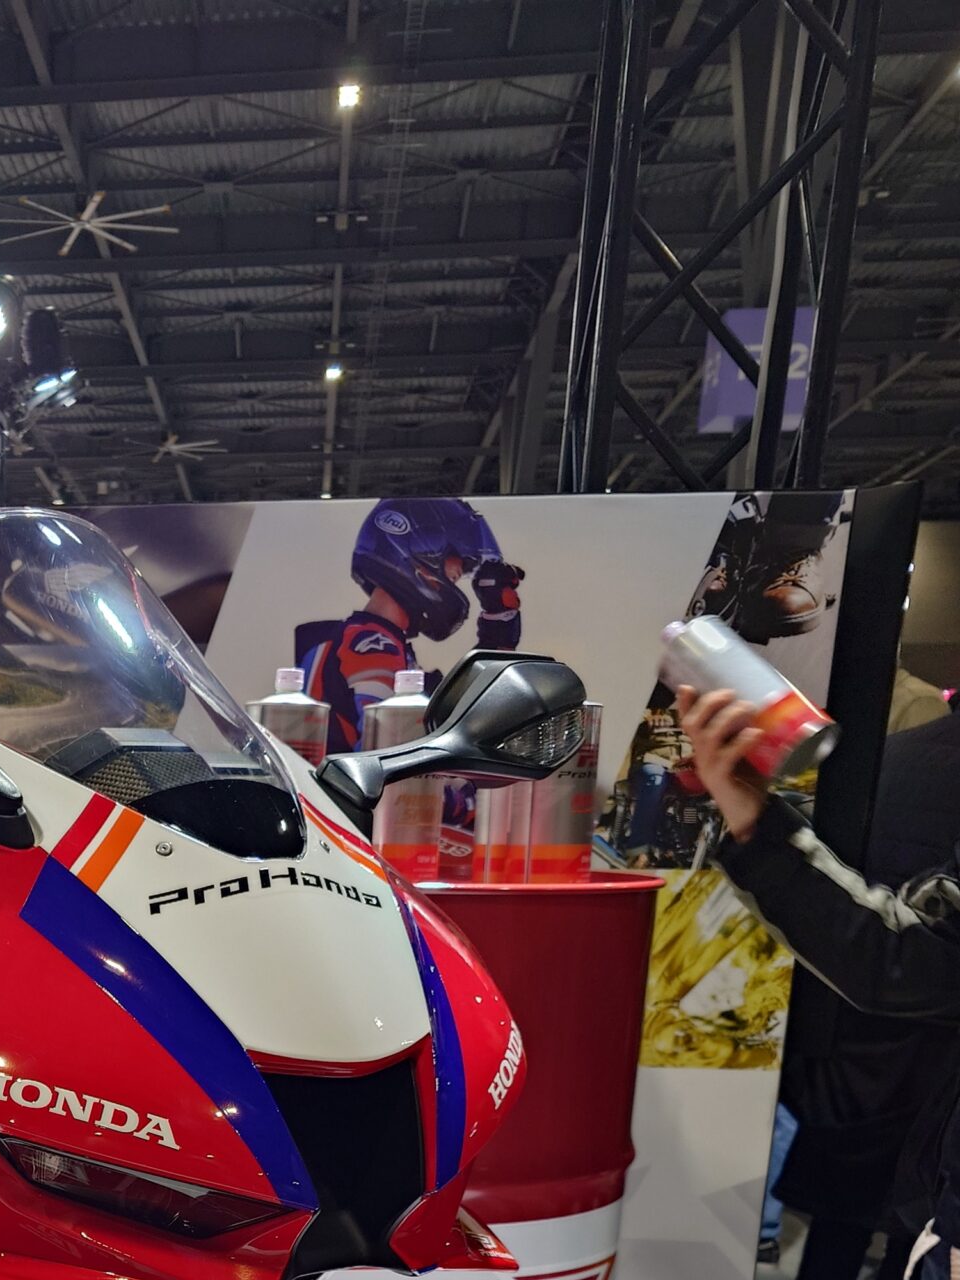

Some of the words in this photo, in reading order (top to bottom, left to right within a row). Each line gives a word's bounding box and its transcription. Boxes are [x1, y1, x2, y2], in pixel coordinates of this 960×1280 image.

[148, 877, 250, 915] Pro
[259, 867, 383, 909] Honda
[487, 1020, 523, 1110] HOND
